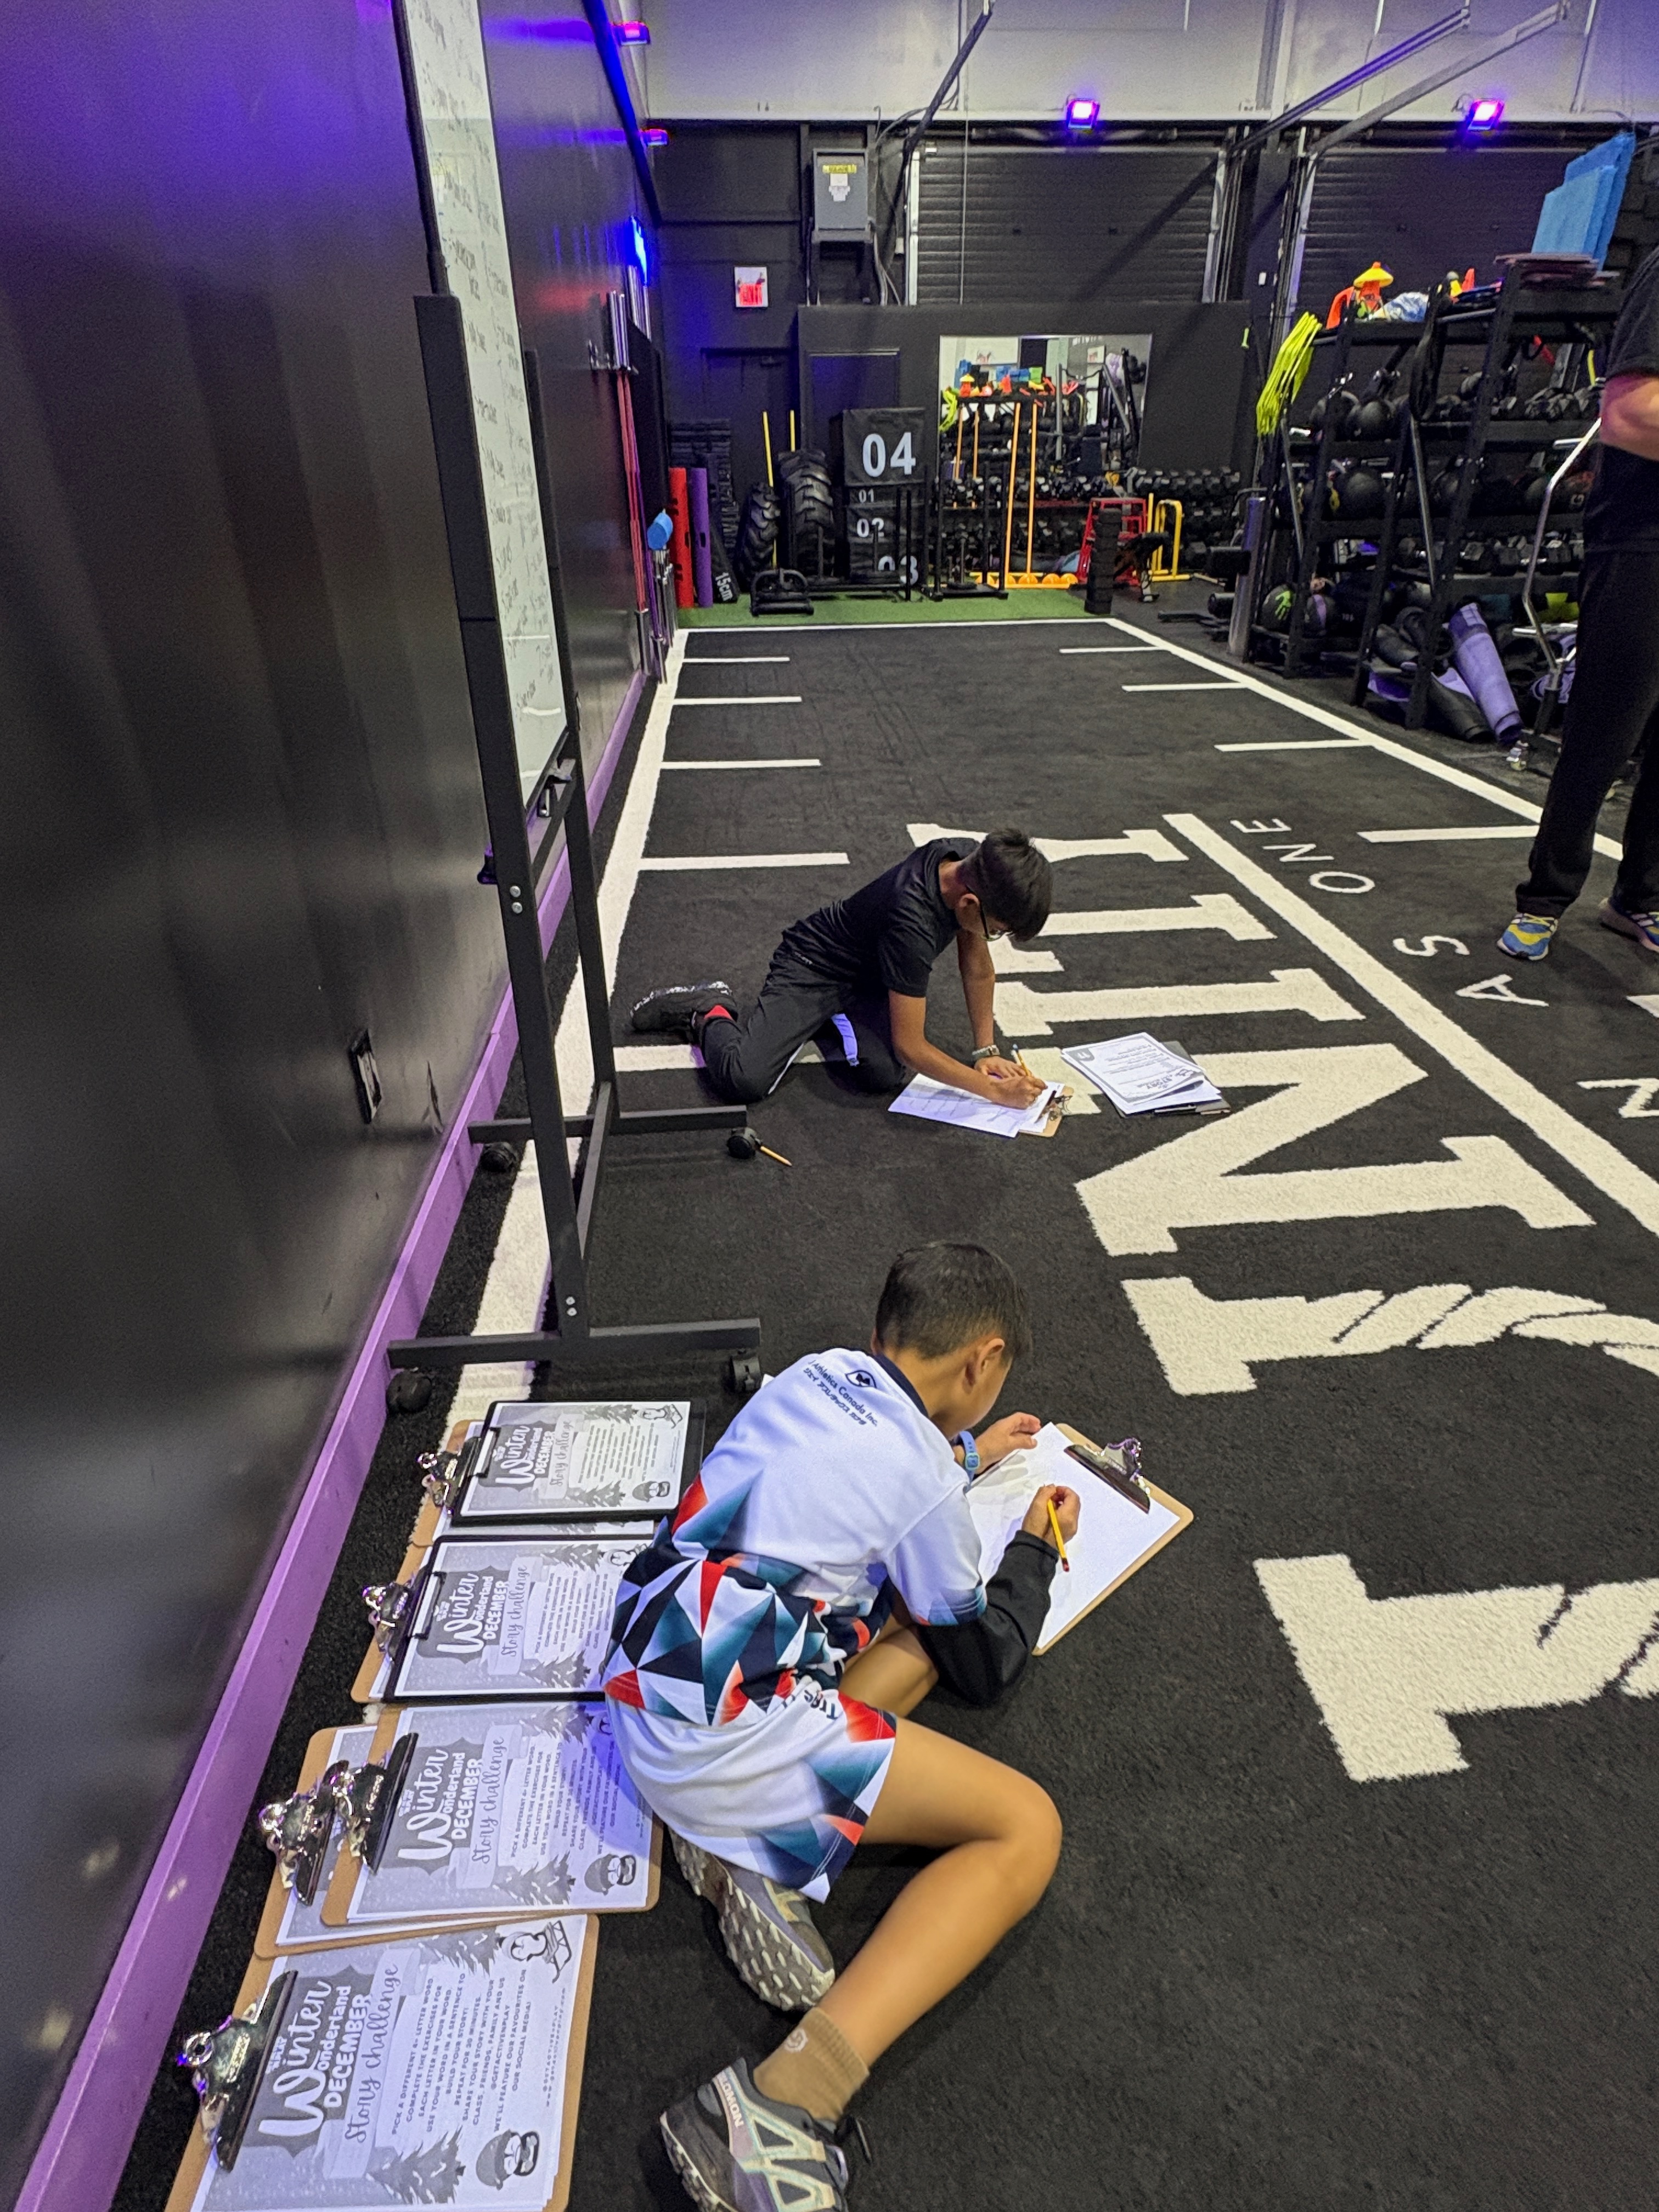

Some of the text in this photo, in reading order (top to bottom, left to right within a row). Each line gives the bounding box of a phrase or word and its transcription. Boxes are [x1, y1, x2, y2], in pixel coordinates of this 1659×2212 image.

[862, 432, 916, 477] 04
[858, 489, 874, 503] 01
[857, 518, 884, 538] 02
[715, 572, 733, 601] 15cm
[1229, 817, 1376, 894] ONE
[1392, 934, 1550, 1007] AS
[812, 1363, 838, 1389] Athletics
[838, 1386, 866, 1414] Canada
[865, 1412, 878, 1427] Inc.
[495, 1426, 535, 1484] Winter
[534, 1431, 555, 1474] DECEMBER
[436, 1573, 484, 1654] Winter
[483, 1581, 509, 1640] DECEMBER
[501, 1565, 529, 1657] Story challenge
[397, 1750, 453, 1859] Winter
[451, 1759, 482, 1839] DECEMBER
[472, 1736, 506, 1864] Story challenge
[494, 1991, 503, 2010] AND
[498, 1978, 505, 1989] US
[519, 1970, 527, 1982] ON
[435, 2019, 445, 2042] YOUR
[487, 2013, 498, 2044] FAMILY
[510, 1984, 524, 2038] FAVOURITES
[258, 1981, 332, 2136] Winter
[323, 1994, 371, 2107] DECEMBER
[345, 1964, 400, 2143] Story challenge
[391, 2112, 402, 2134] PICK
[399, 2051, 416, 2098] DIFFERENT
[414, 2008, 426, 2035] LETTER
[421, 1978, 433, 2005] WORD
[406, 1986, 442, 2122] COMPLETE THE EXERCISES FOR
[425, 2058, 437, 2087] LETTER
[426, 2115, 435, 2132] USE
[431, 2086, 441, 2111] YOUR
[437, 2054, 448, 2083] WORD
[443, 2041, 451, 2051] IN
[448, 1987, 462, 2029] SENTENCE
[458, 1973, 466, 1984] TO
[432, 2046, 439, 2055] IN
[445, 2068, 456, 2094] BUILD
[452, 2041, 462, 2064] YOUR
[462, 1980, 494, 2121] SHARE YOUR STORY WITH YOUR
[506, 2041, 515, 2059] OUR
[516, 2035, 526, 2069] SOCIAL
[418, 2092, 429, 2117] EACH
[454, 2072, 466, 2106] REPEAT
[461, 2051, 470, 2069] FOR
[499, 2063, 511, 2101] FEATURE
[512, 2072, 521, 2091] OUR
